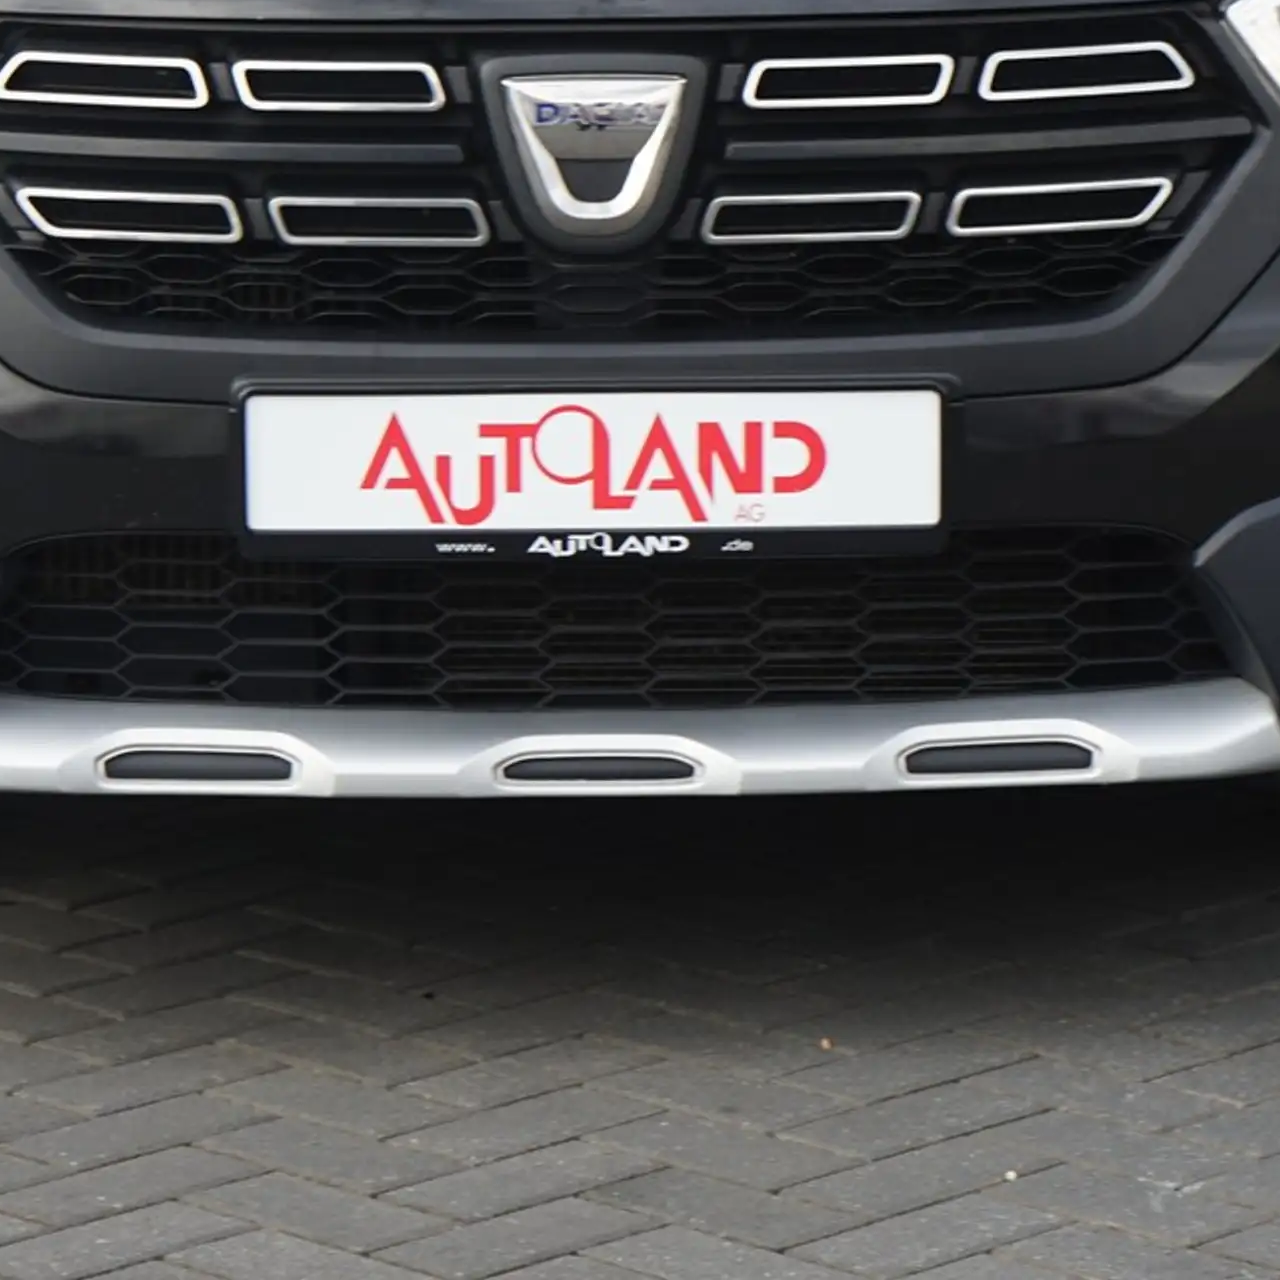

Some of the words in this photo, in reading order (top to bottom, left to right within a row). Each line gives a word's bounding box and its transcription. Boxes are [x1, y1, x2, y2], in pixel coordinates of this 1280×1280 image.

[360, 404, 827, 525] AUTOLAND
[734, 503, 765, 522] AG
[528, 532, 690, 557] AUTOLAND
